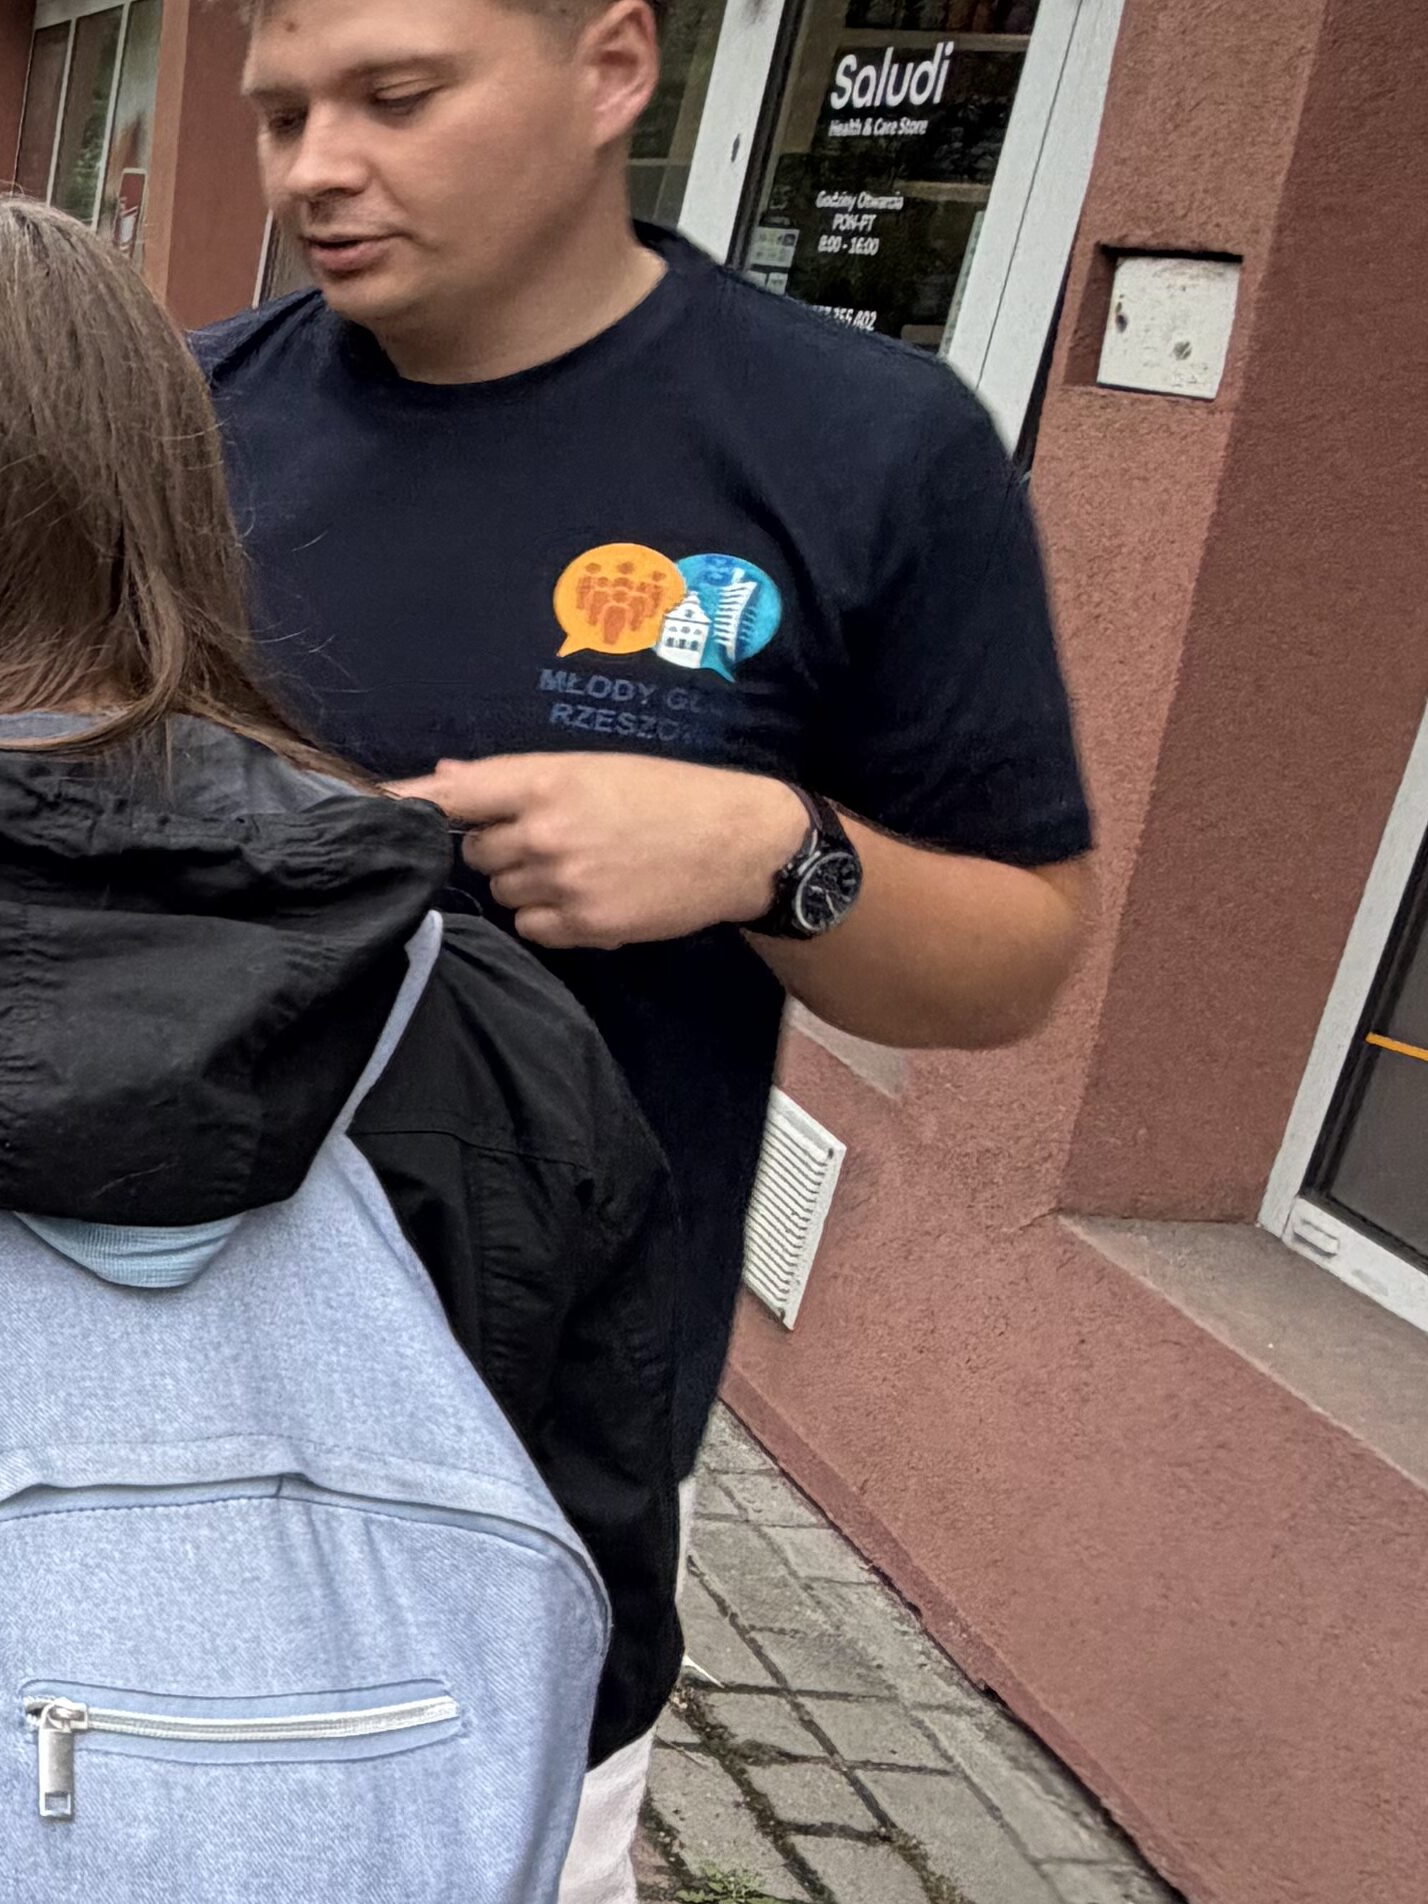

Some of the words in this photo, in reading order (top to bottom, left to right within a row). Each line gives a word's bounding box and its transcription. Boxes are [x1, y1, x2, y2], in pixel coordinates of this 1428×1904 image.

[830, 41, 954, 110] Saludi
[828, 118, 862, 137] Health
[862, 117, 873, 136] &
[873, 117, 898, 136] Care
[897, 116, 929, 135] Store
[538, 668, 657, 704] MŁODY
